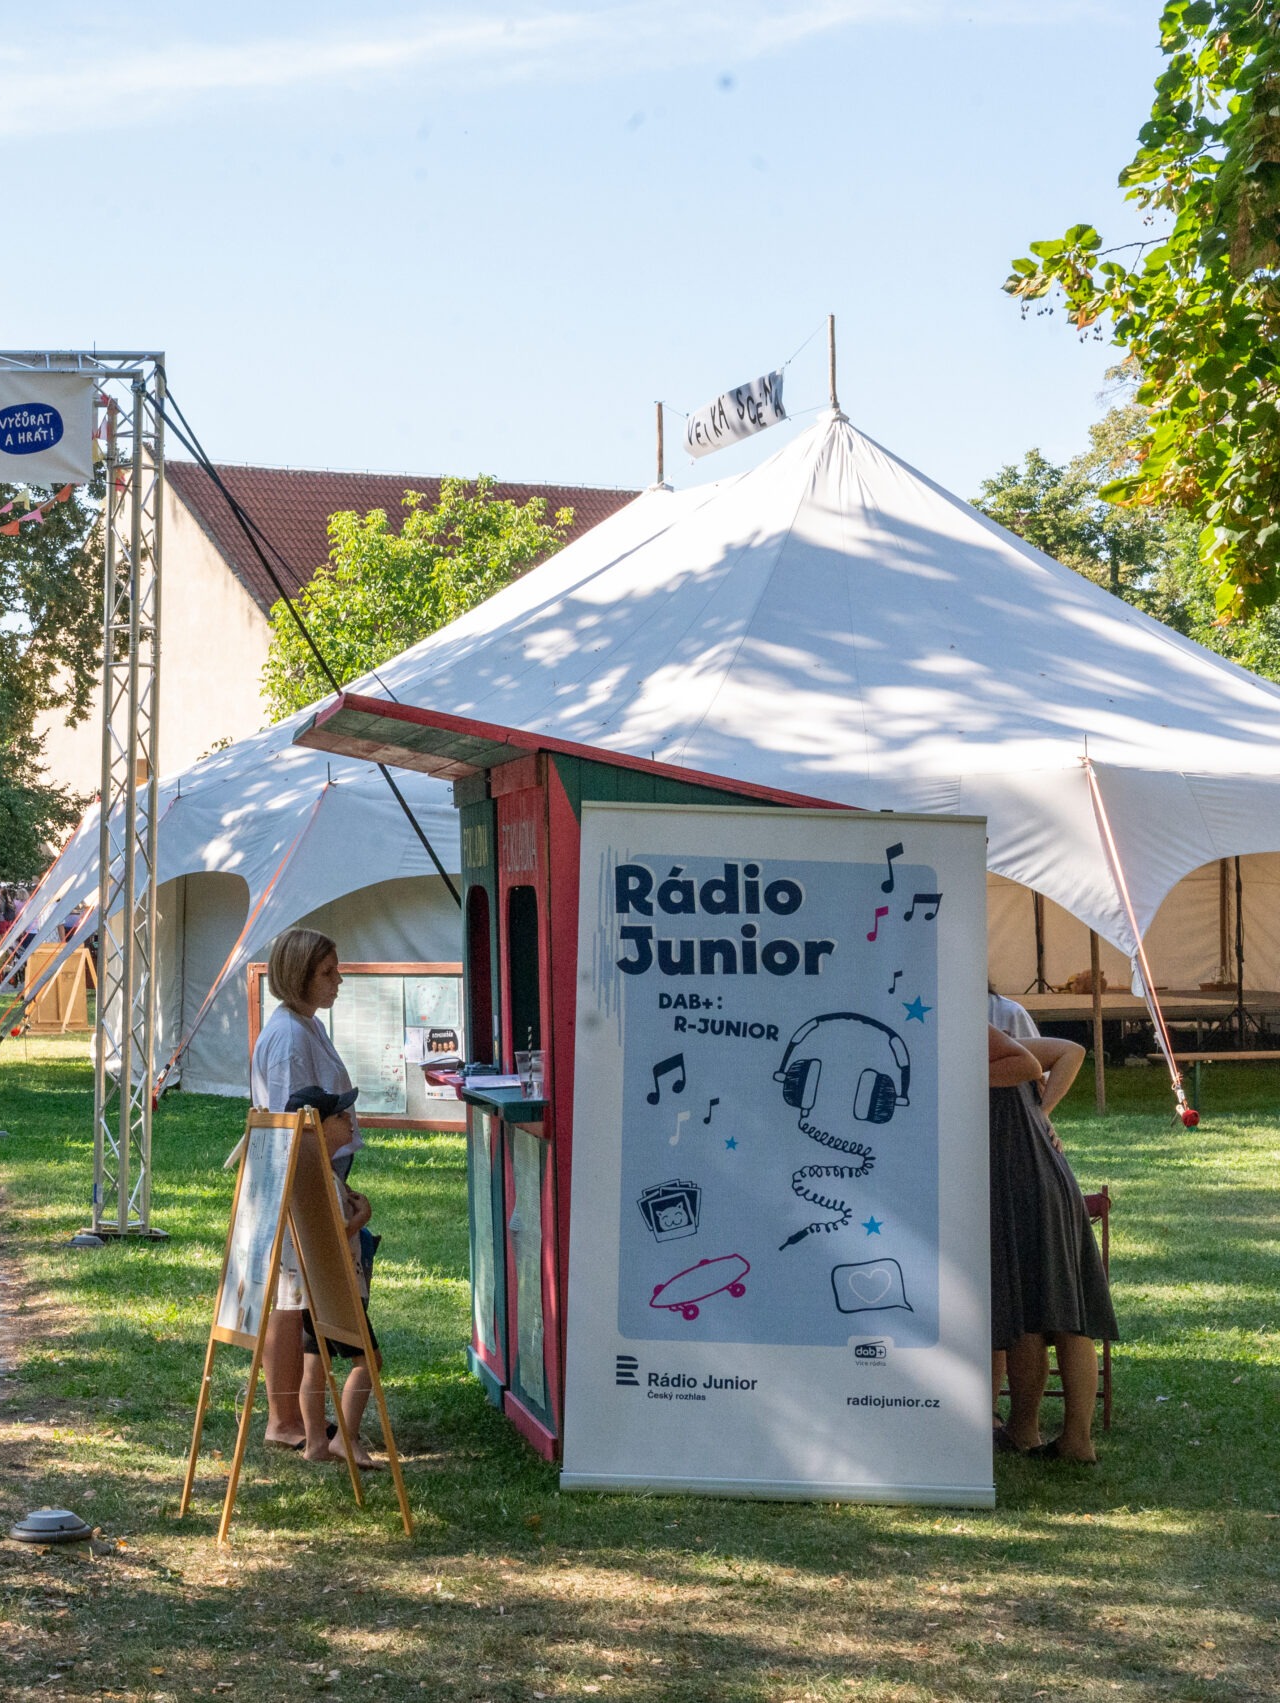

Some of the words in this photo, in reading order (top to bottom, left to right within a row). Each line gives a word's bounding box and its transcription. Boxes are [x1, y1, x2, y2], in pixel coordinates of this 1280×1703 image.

[5, 433, 14, 446] A
[18, 427, 54, 444] HRÁT!
[615, 863, 804, 917] Rádio
[616, 923, 836, 976] Junior
[674, 1015, 780, 1041] R-JUNIOR
[647, 1372, 697, 1389] Rádio
[702, 1374, 759, 1391] Junior
[647, 1389, 673, 1400] Český
[675, 1391, 706, 1401] rozhlas
[846, 1395, 941, 1409] radiojunior.cz
